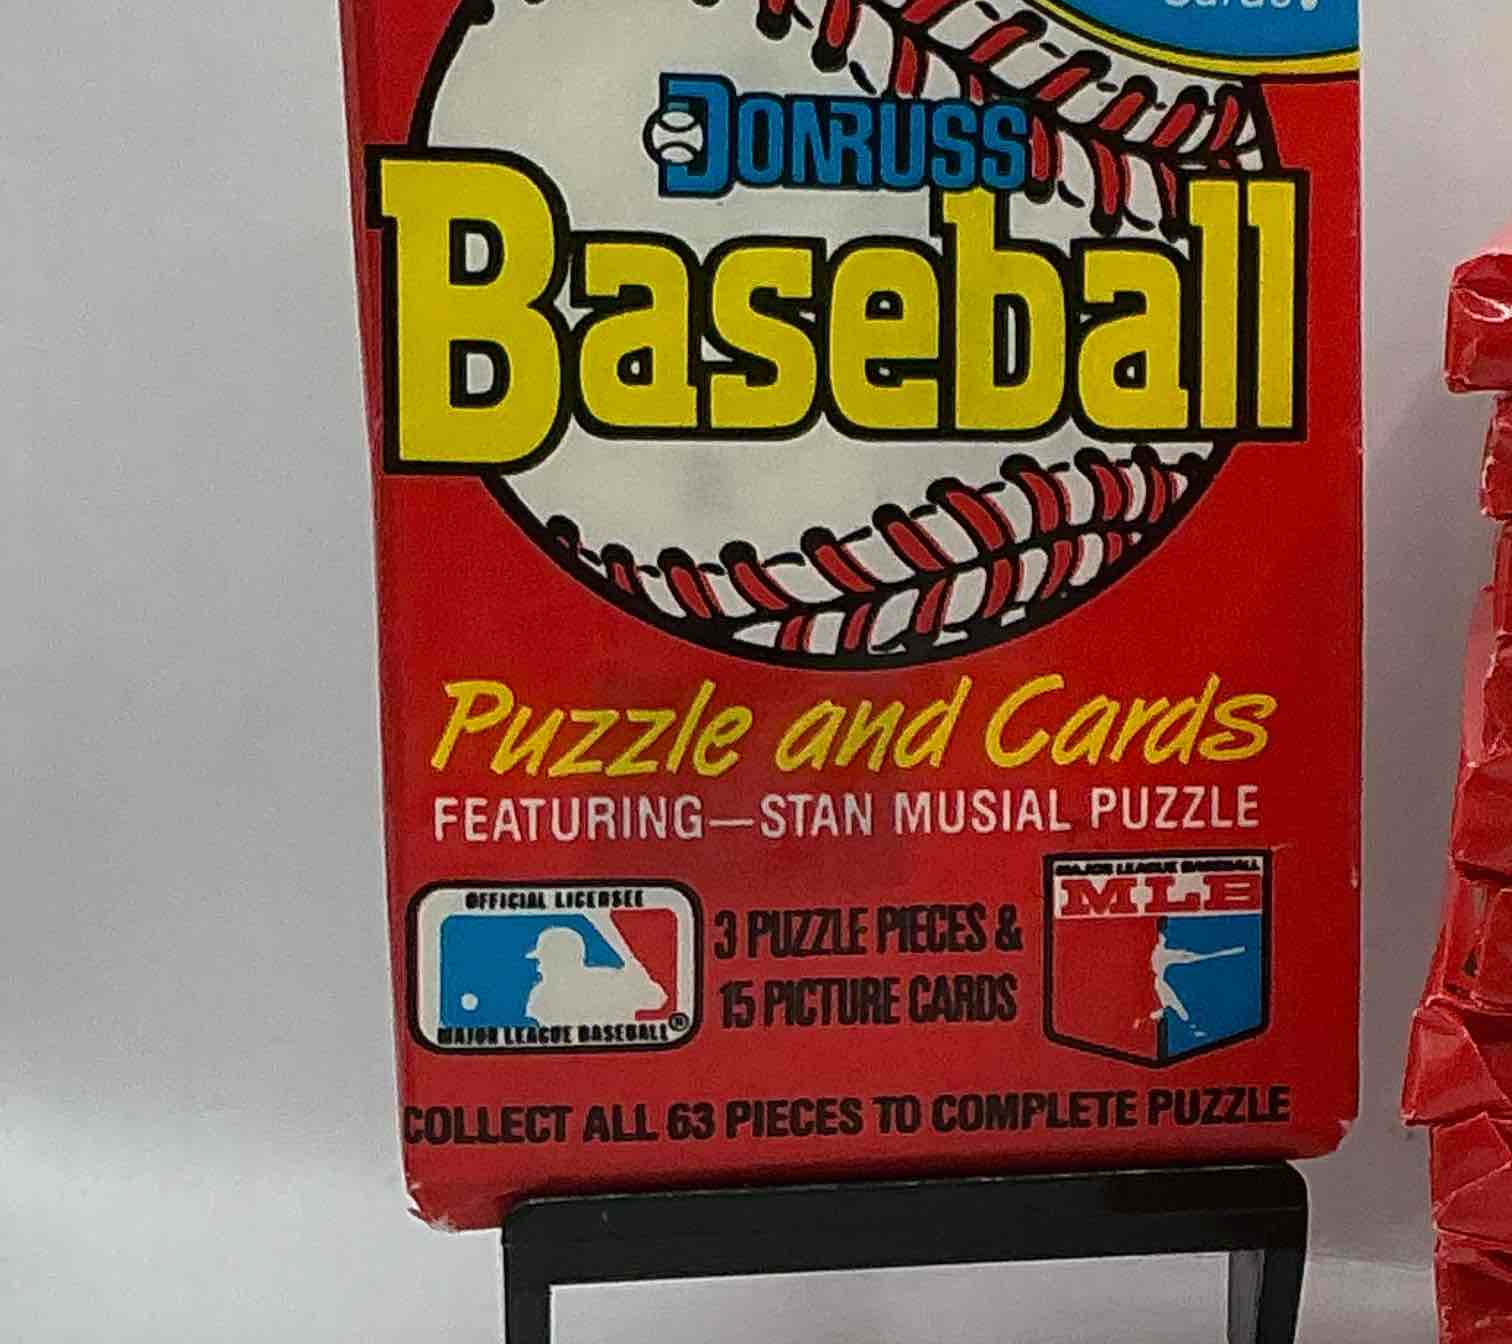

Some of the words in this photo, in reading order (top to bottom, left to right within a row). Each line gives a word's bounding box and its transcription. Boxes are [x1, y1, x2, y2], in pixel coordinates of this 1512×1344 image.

[656, 74, 1030, 198] DONRUSS
[370, 146, 1308, 474] Baseball
[431, 679, 753, 778] Puzzle
[775, 674, 973, 773] and
[985, 672, 1278, 768] Cards
[895, 788, 1072, 834] MUSIAL
[1091, 784, 1260, 830] PUZZLE
[465, 892, 546, 910] OFFICIAL
[1061, 873, 1262, 916] MLB
[713, 909, 737, 960] 3
[746, 907, 869, 958] PUZZLE
[876, 902, 987, 954] PIECES
[995, 904, 1023, 951] &
[719, 980, 757, 1029] 15
[763, 977, 900, 1027] PICTURE
[908, 973, 1019, 1023] CARDS
[437, 1026, 498, 1045] MAJOR
[404, 1105, 572, 1144] COLLECT
[582, 1103, 658, 1143] ALL
[666, 1102, 715, 1140] 63
[725, 1097, 863, 1138] PIECES
[872, 1095, 921, 1134] TO
[931, 1090, 1137, 1133] COMPLETE
[1146, 1085, 1291, 1126] PUZZLE
